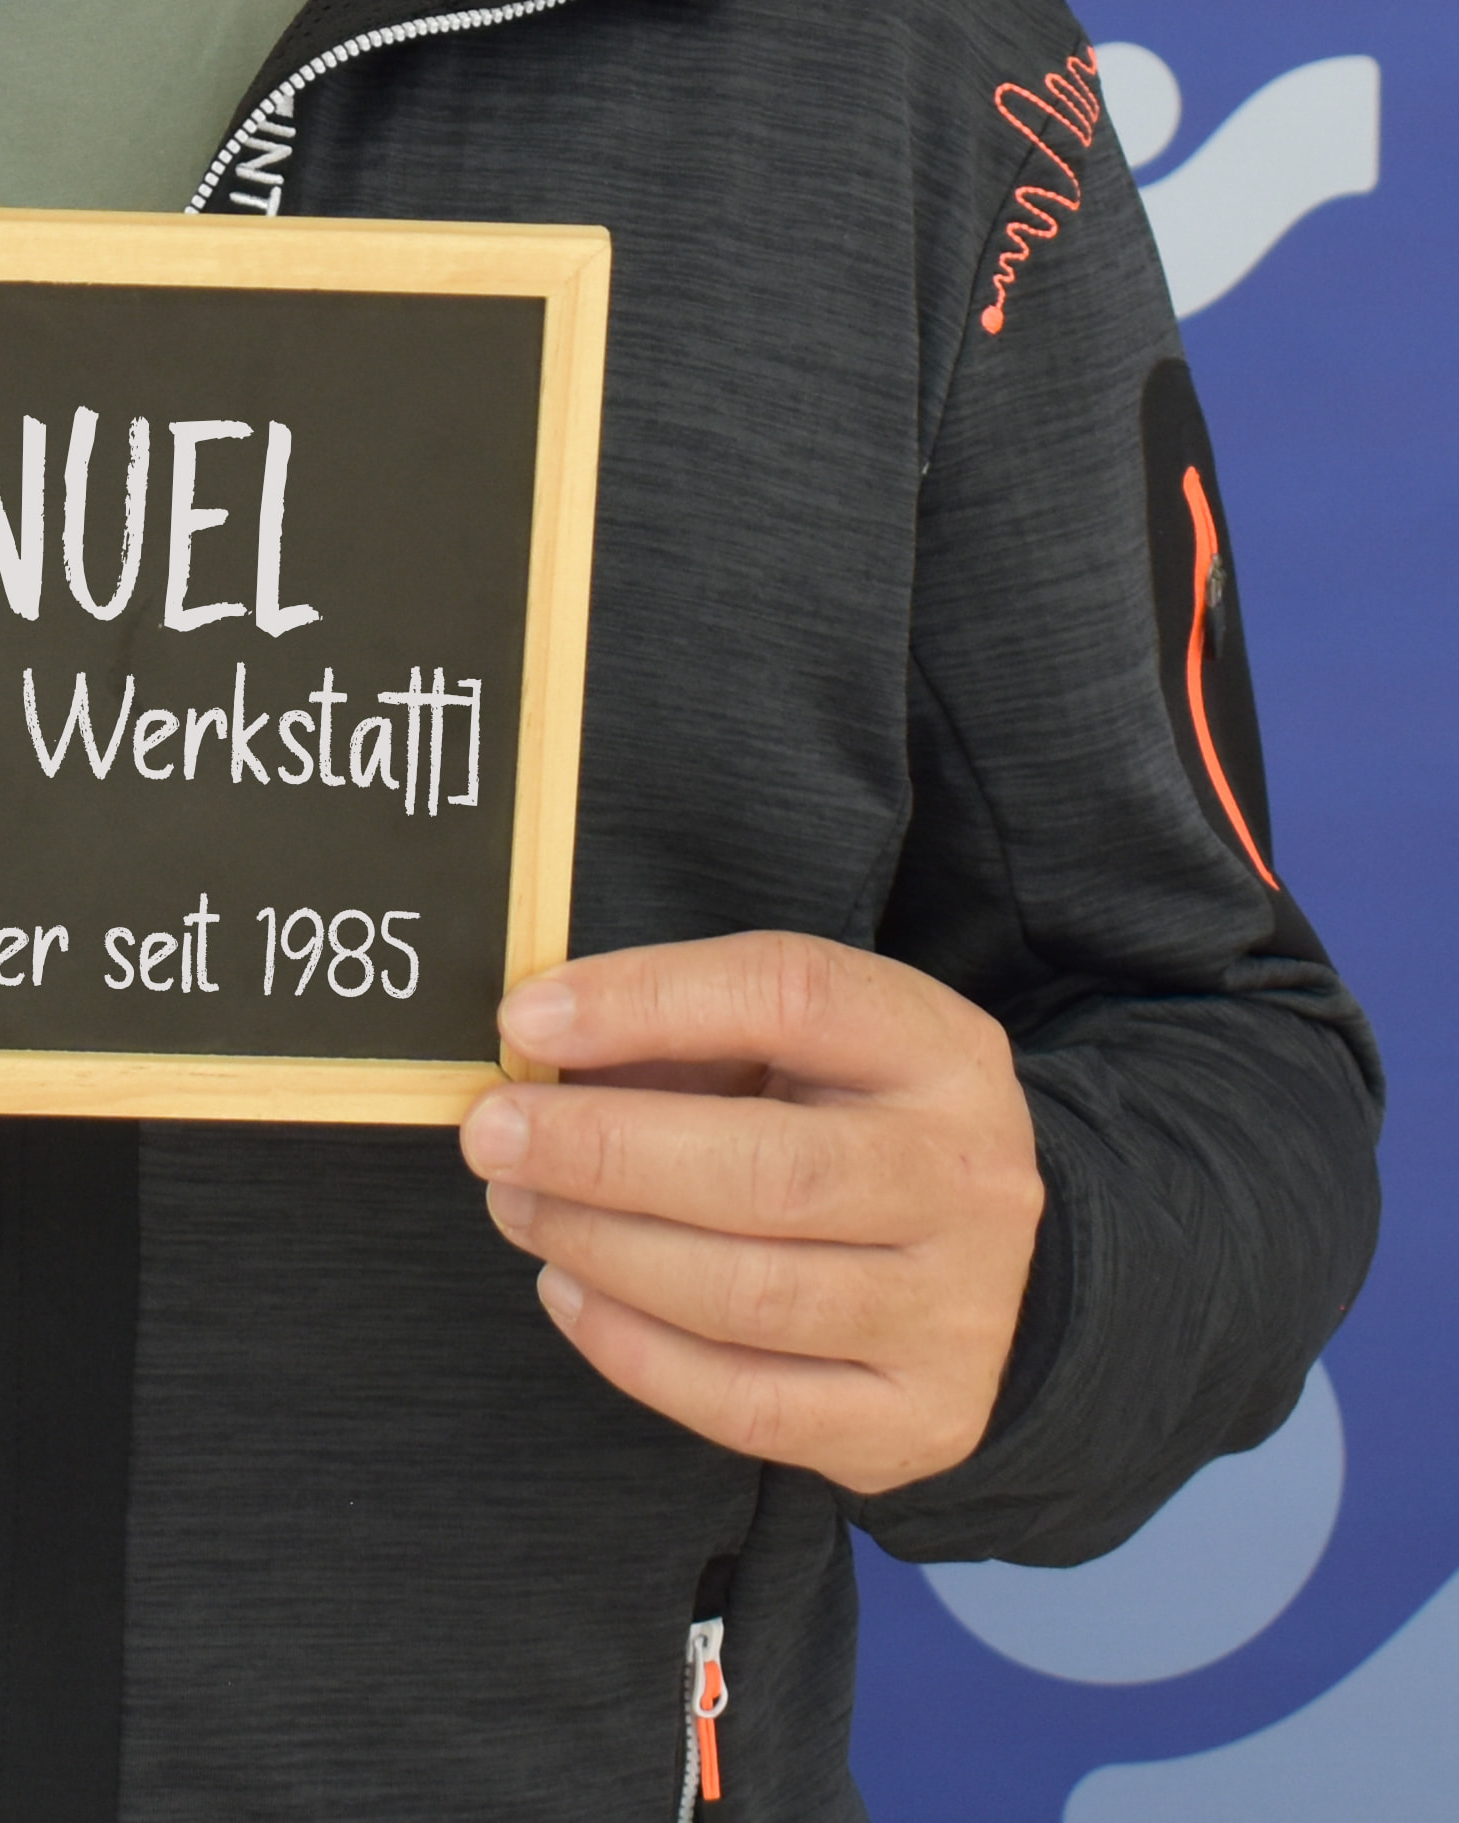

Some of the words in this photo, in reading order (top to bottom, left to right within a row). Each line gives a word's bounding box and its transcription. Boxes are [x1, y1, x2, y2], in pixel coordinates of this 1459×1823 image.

[22, 662, 483, 817] Werkstatt]
[103, 892, 221, 994] seit
[255, 906, 421, 1000] 1985
